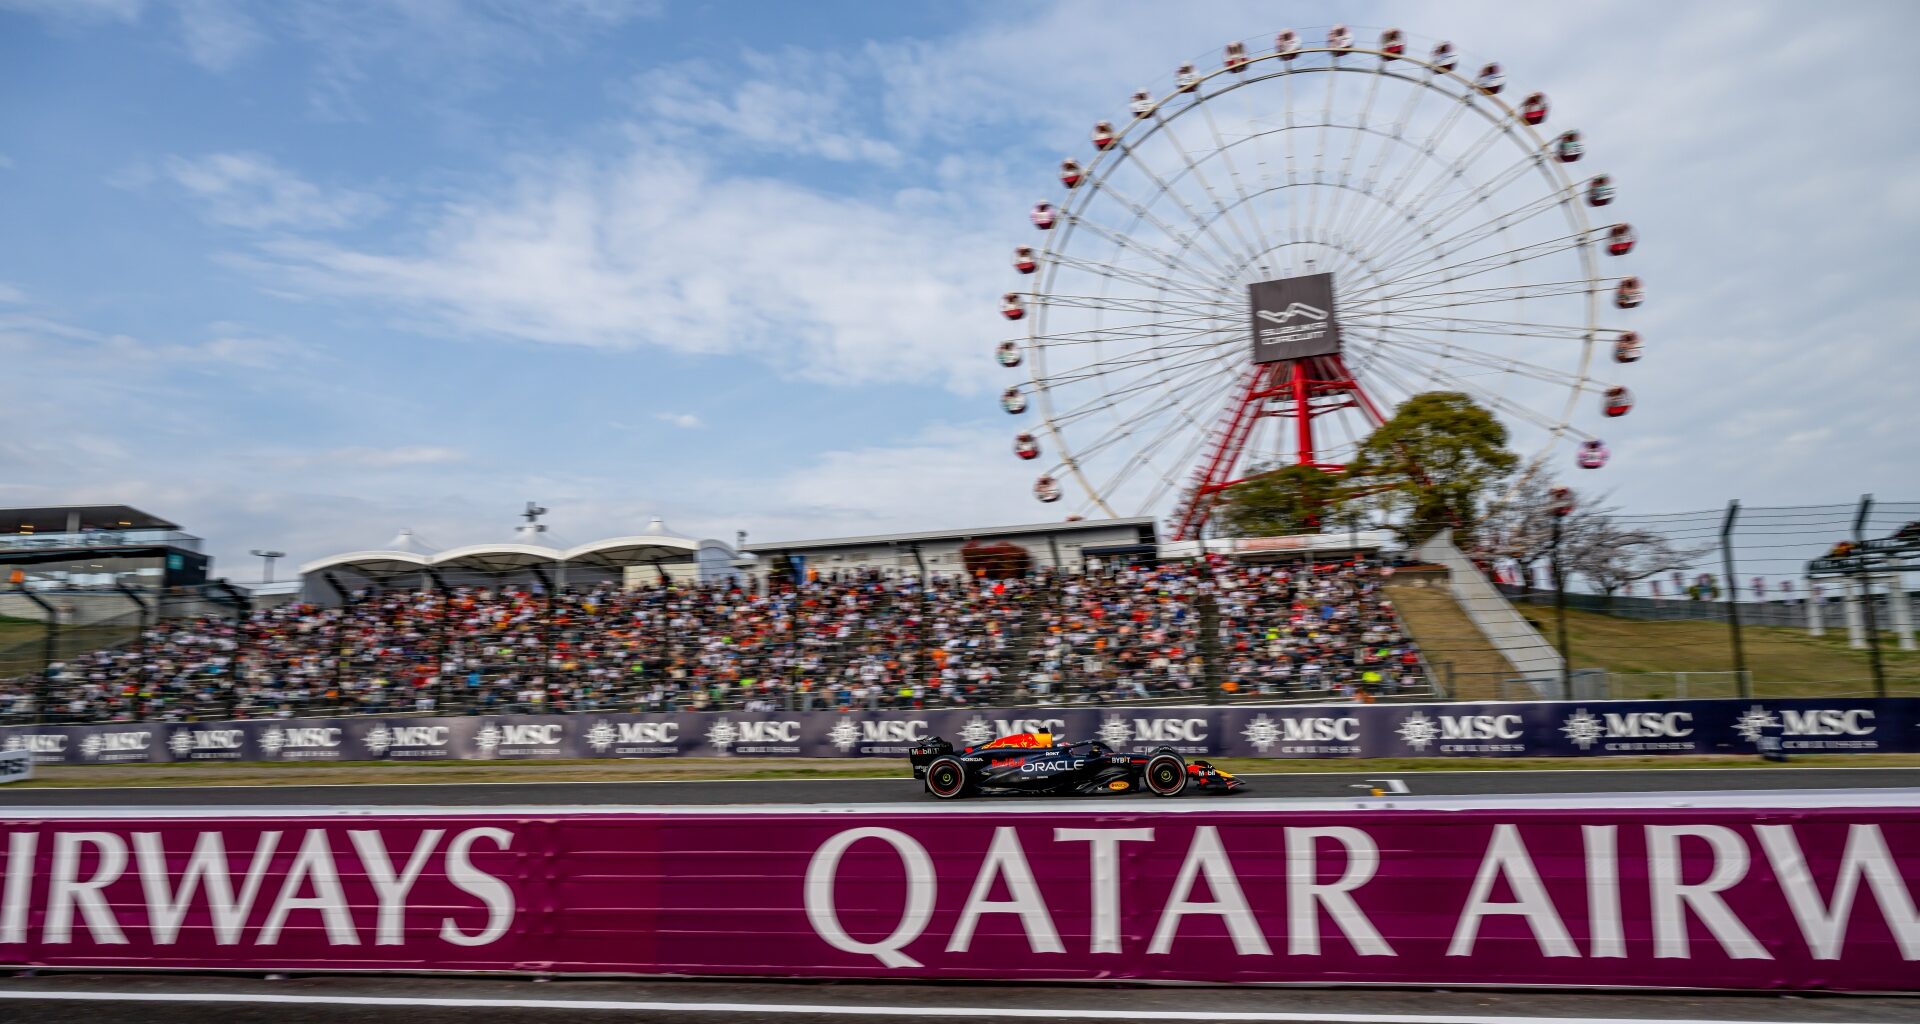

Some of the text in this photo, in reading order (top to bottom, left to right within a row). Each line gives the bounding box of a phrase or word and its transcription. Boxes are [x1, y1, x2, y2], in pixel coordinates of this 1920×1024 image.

[617, 722, 679, 742] MSC
[738, 722, 800, 742] MSC
[861, 720, 928, 742] MSC
[1133, 718, 1208, 742] MSC
[1281, 718, 1360, 741] MSC
[1438, 714, 1524, 739] MSC
[1603, 712, 1694, 738] MSC
[1779, 710, 1876, 735] MSC
[283, 728, 341, 746] MSC
[390, 726, 449, 746] MSC
[501, 725, 562, 744] MSC
[1021, 760, 1084, 772] ORACLE
[803, 824, 1920, 968] QATAR AIRW
